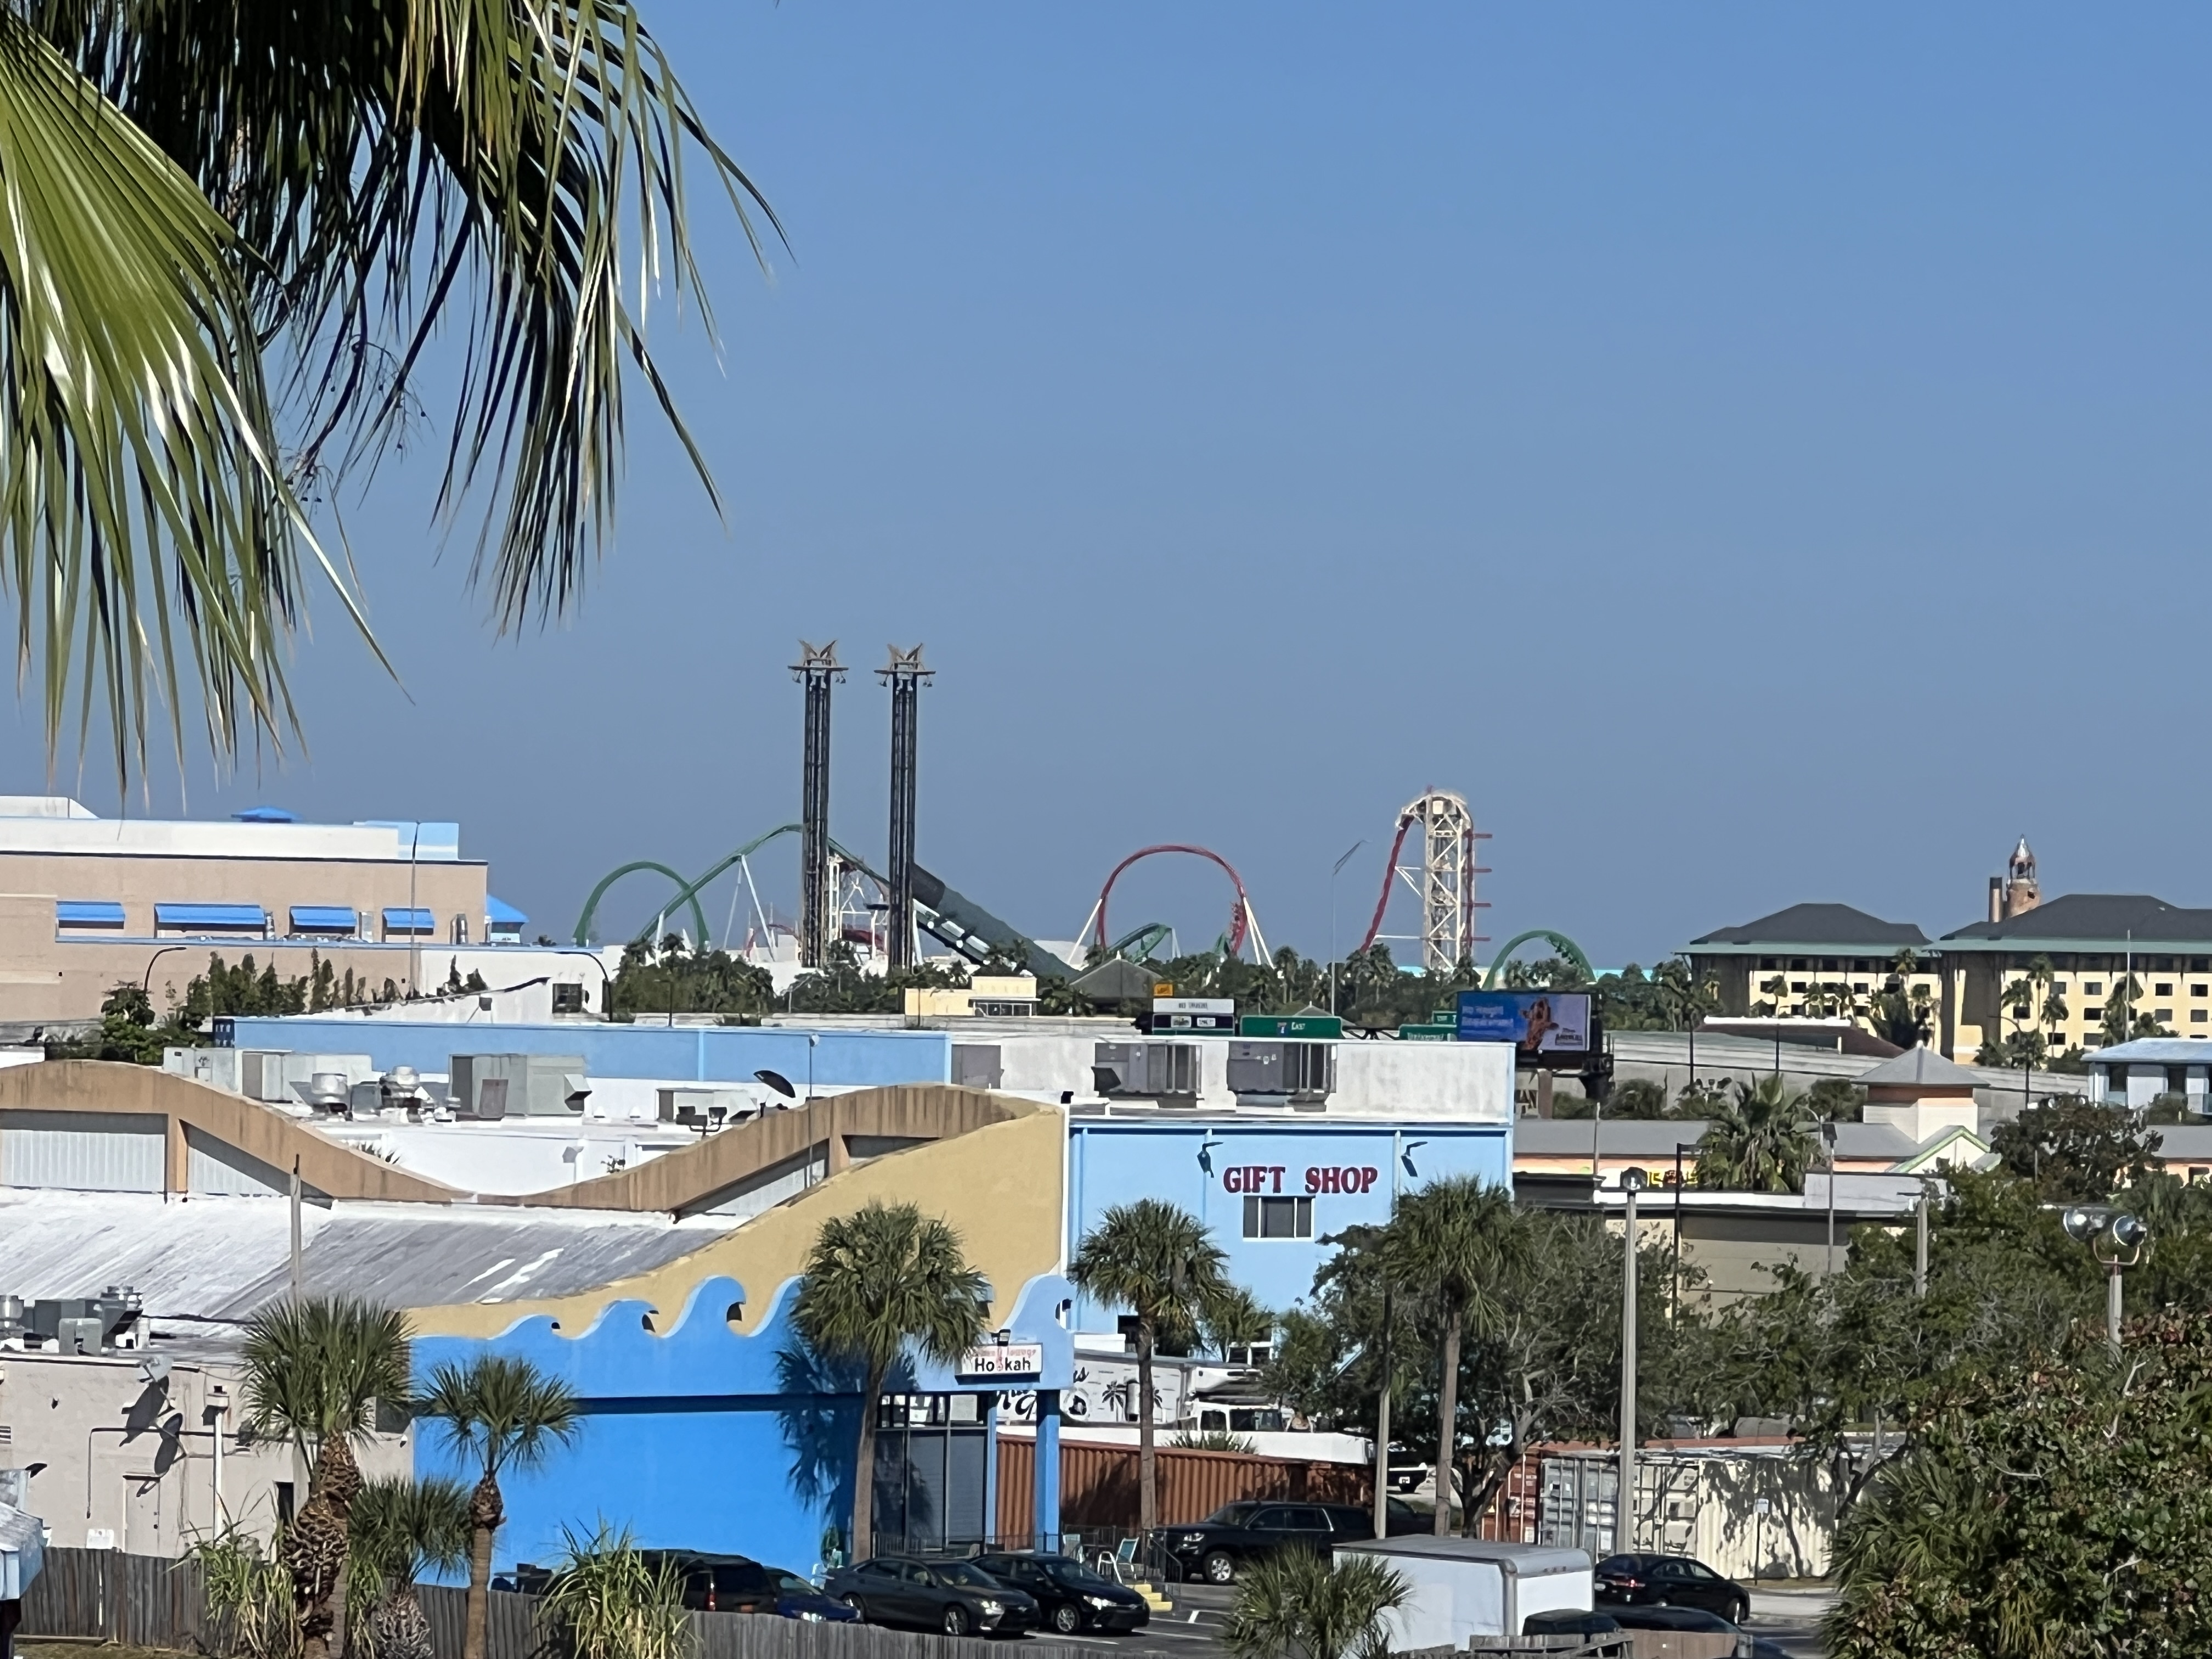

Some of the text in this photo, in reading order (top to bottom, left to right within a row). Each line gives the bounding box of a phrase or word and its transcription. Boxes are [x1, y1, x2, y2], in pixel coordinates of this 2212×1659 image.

[1223, 1166, 1378, 1194] GIFT SHOP
[975, 1357, 1031, 1372] Hokah
